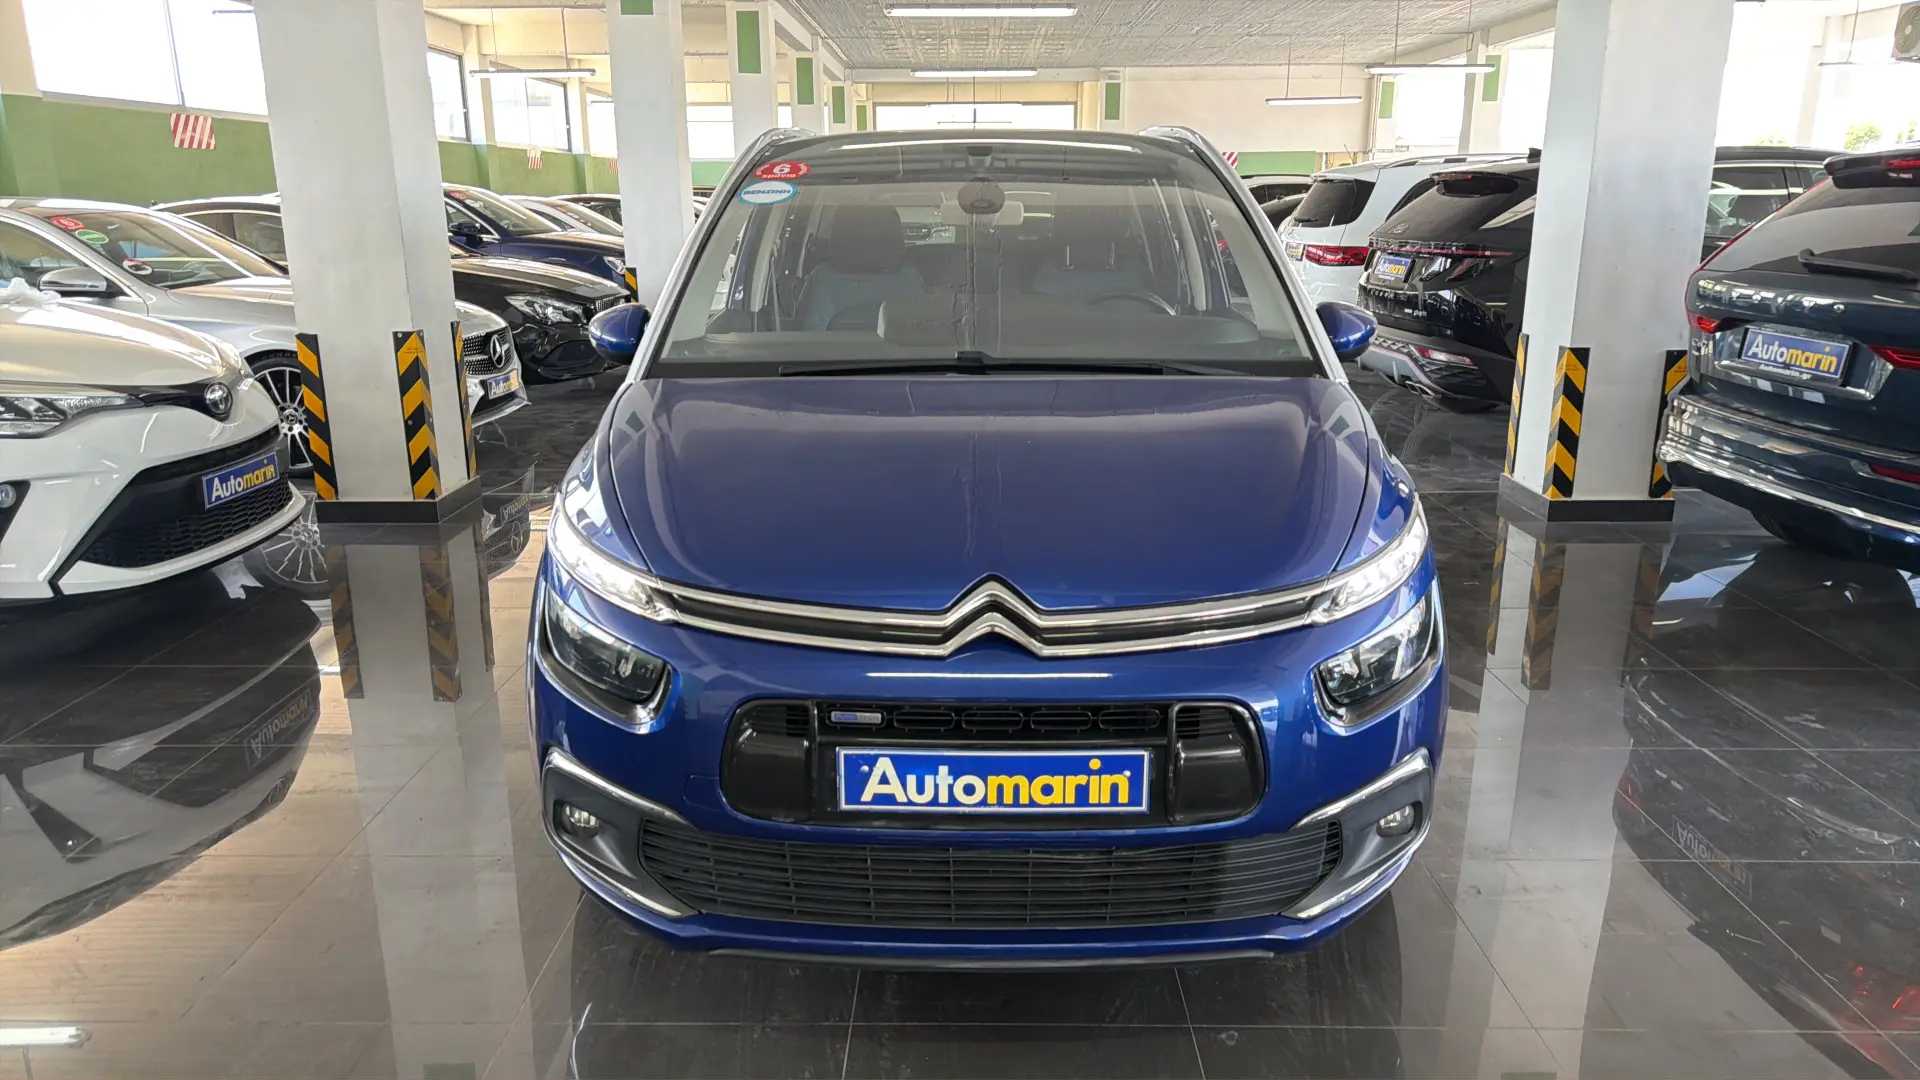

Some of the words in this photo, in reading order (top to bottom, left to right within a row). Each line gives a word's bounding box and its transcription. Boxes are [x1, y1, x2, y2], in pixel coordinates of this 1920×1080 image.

[772, 163, 791, 174] 6
[1748, 334, 1837, 373] Automarin
[1759, 364, 1812, 380] Automarin.gr
[212, 458, 275, 502] Automarin
[860, 757, 1128, 804] Automarin
